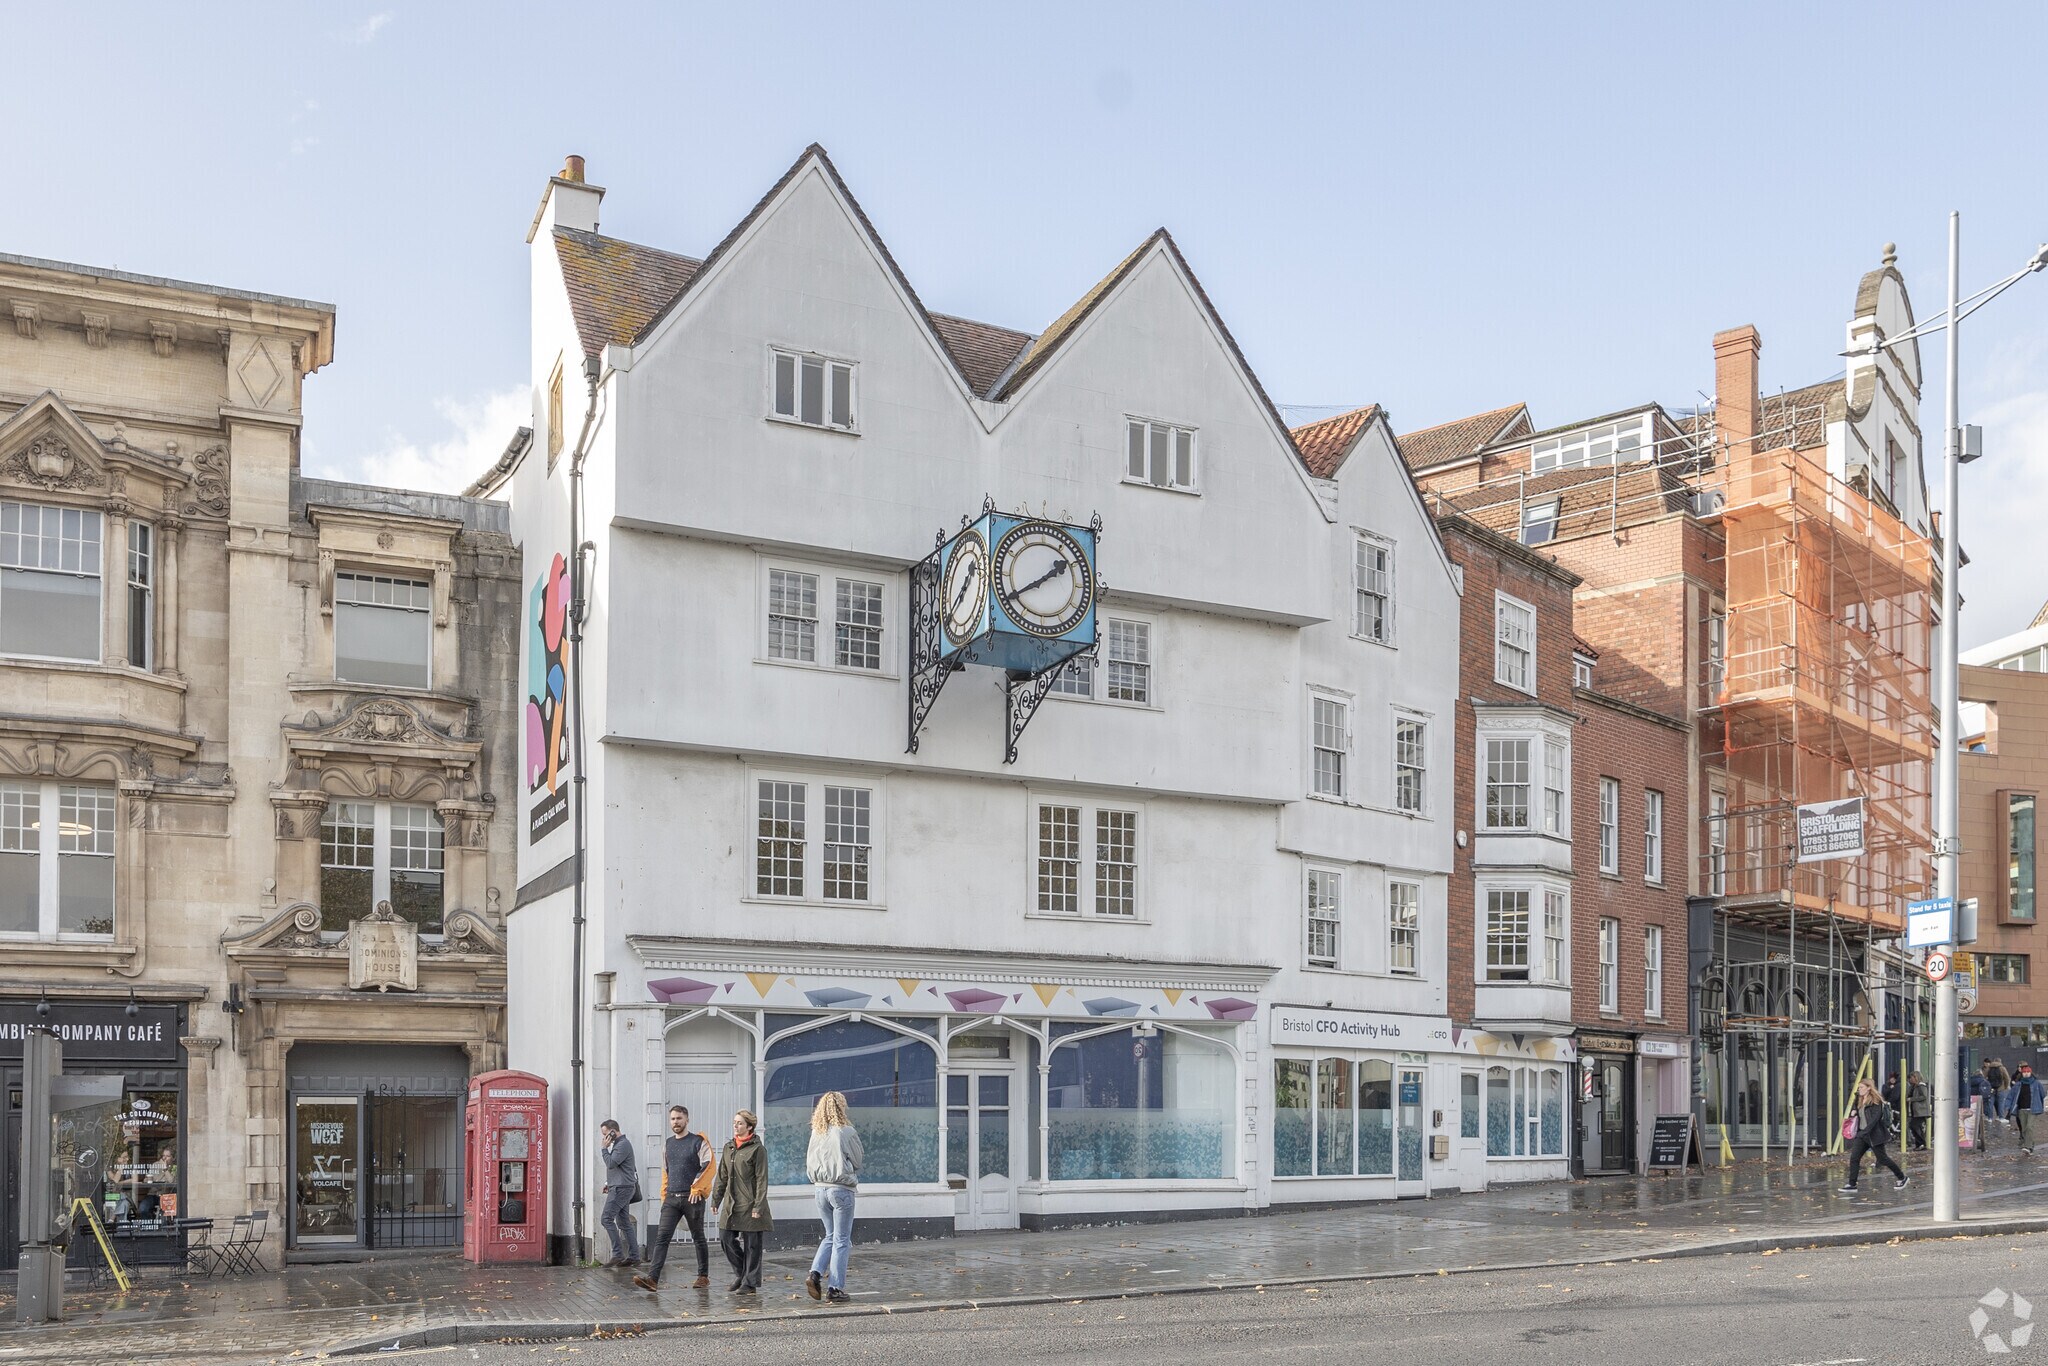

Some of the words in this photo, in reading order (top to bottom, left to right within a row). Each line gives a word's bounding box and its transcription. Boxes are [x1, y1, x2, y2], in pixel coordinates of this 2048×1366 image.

[1800, 813, 1836, 828] BRISTOL
[1835, 812, 1860, 823] ACCESS
[1801, 820, 1860, 837] SCAFFOLDING
[1802, 835, 1828, 846] 07853
[1828, 831, 1860, 843] 387066
[1803, 843, 1828, 855] 07583
[1828, 839, 1860, 851] 866505
[1908, 906, 1924, 914] Stand
[1932, 902, 1938, 910] 5
[1938, 900, 1952, 909] taxis
[359, 948, 409, 958] DOMINIONS
[364, 962, 401, 973] HOUSE
[1930, 960, 1945, 972] 20
[0, 1023, 46, 1041] MBI
[52, 1023, 122, 1042] COMPANY
[127, 1022, 162, 1042] CAFÉ
[1282, 1017, 1314, 1033] Bristol
[1316, 1020, 1339, 1034] CFO
[1340, 1021, 1379, 1040] Activity
[1381, 1024, 1400, 1037] Hub
[1434, 1030, 1447, 1040] CFO
[491, 1089, 538, 1097] TELEPHONE
[113, 1112, 127, 1122] THE
[129, 1110, 169, 1122] COLOMBIAN
[310, 1122, 344, 1130] MISCHIEVOUS
[311, 1129, 344, 1144] WOLF
